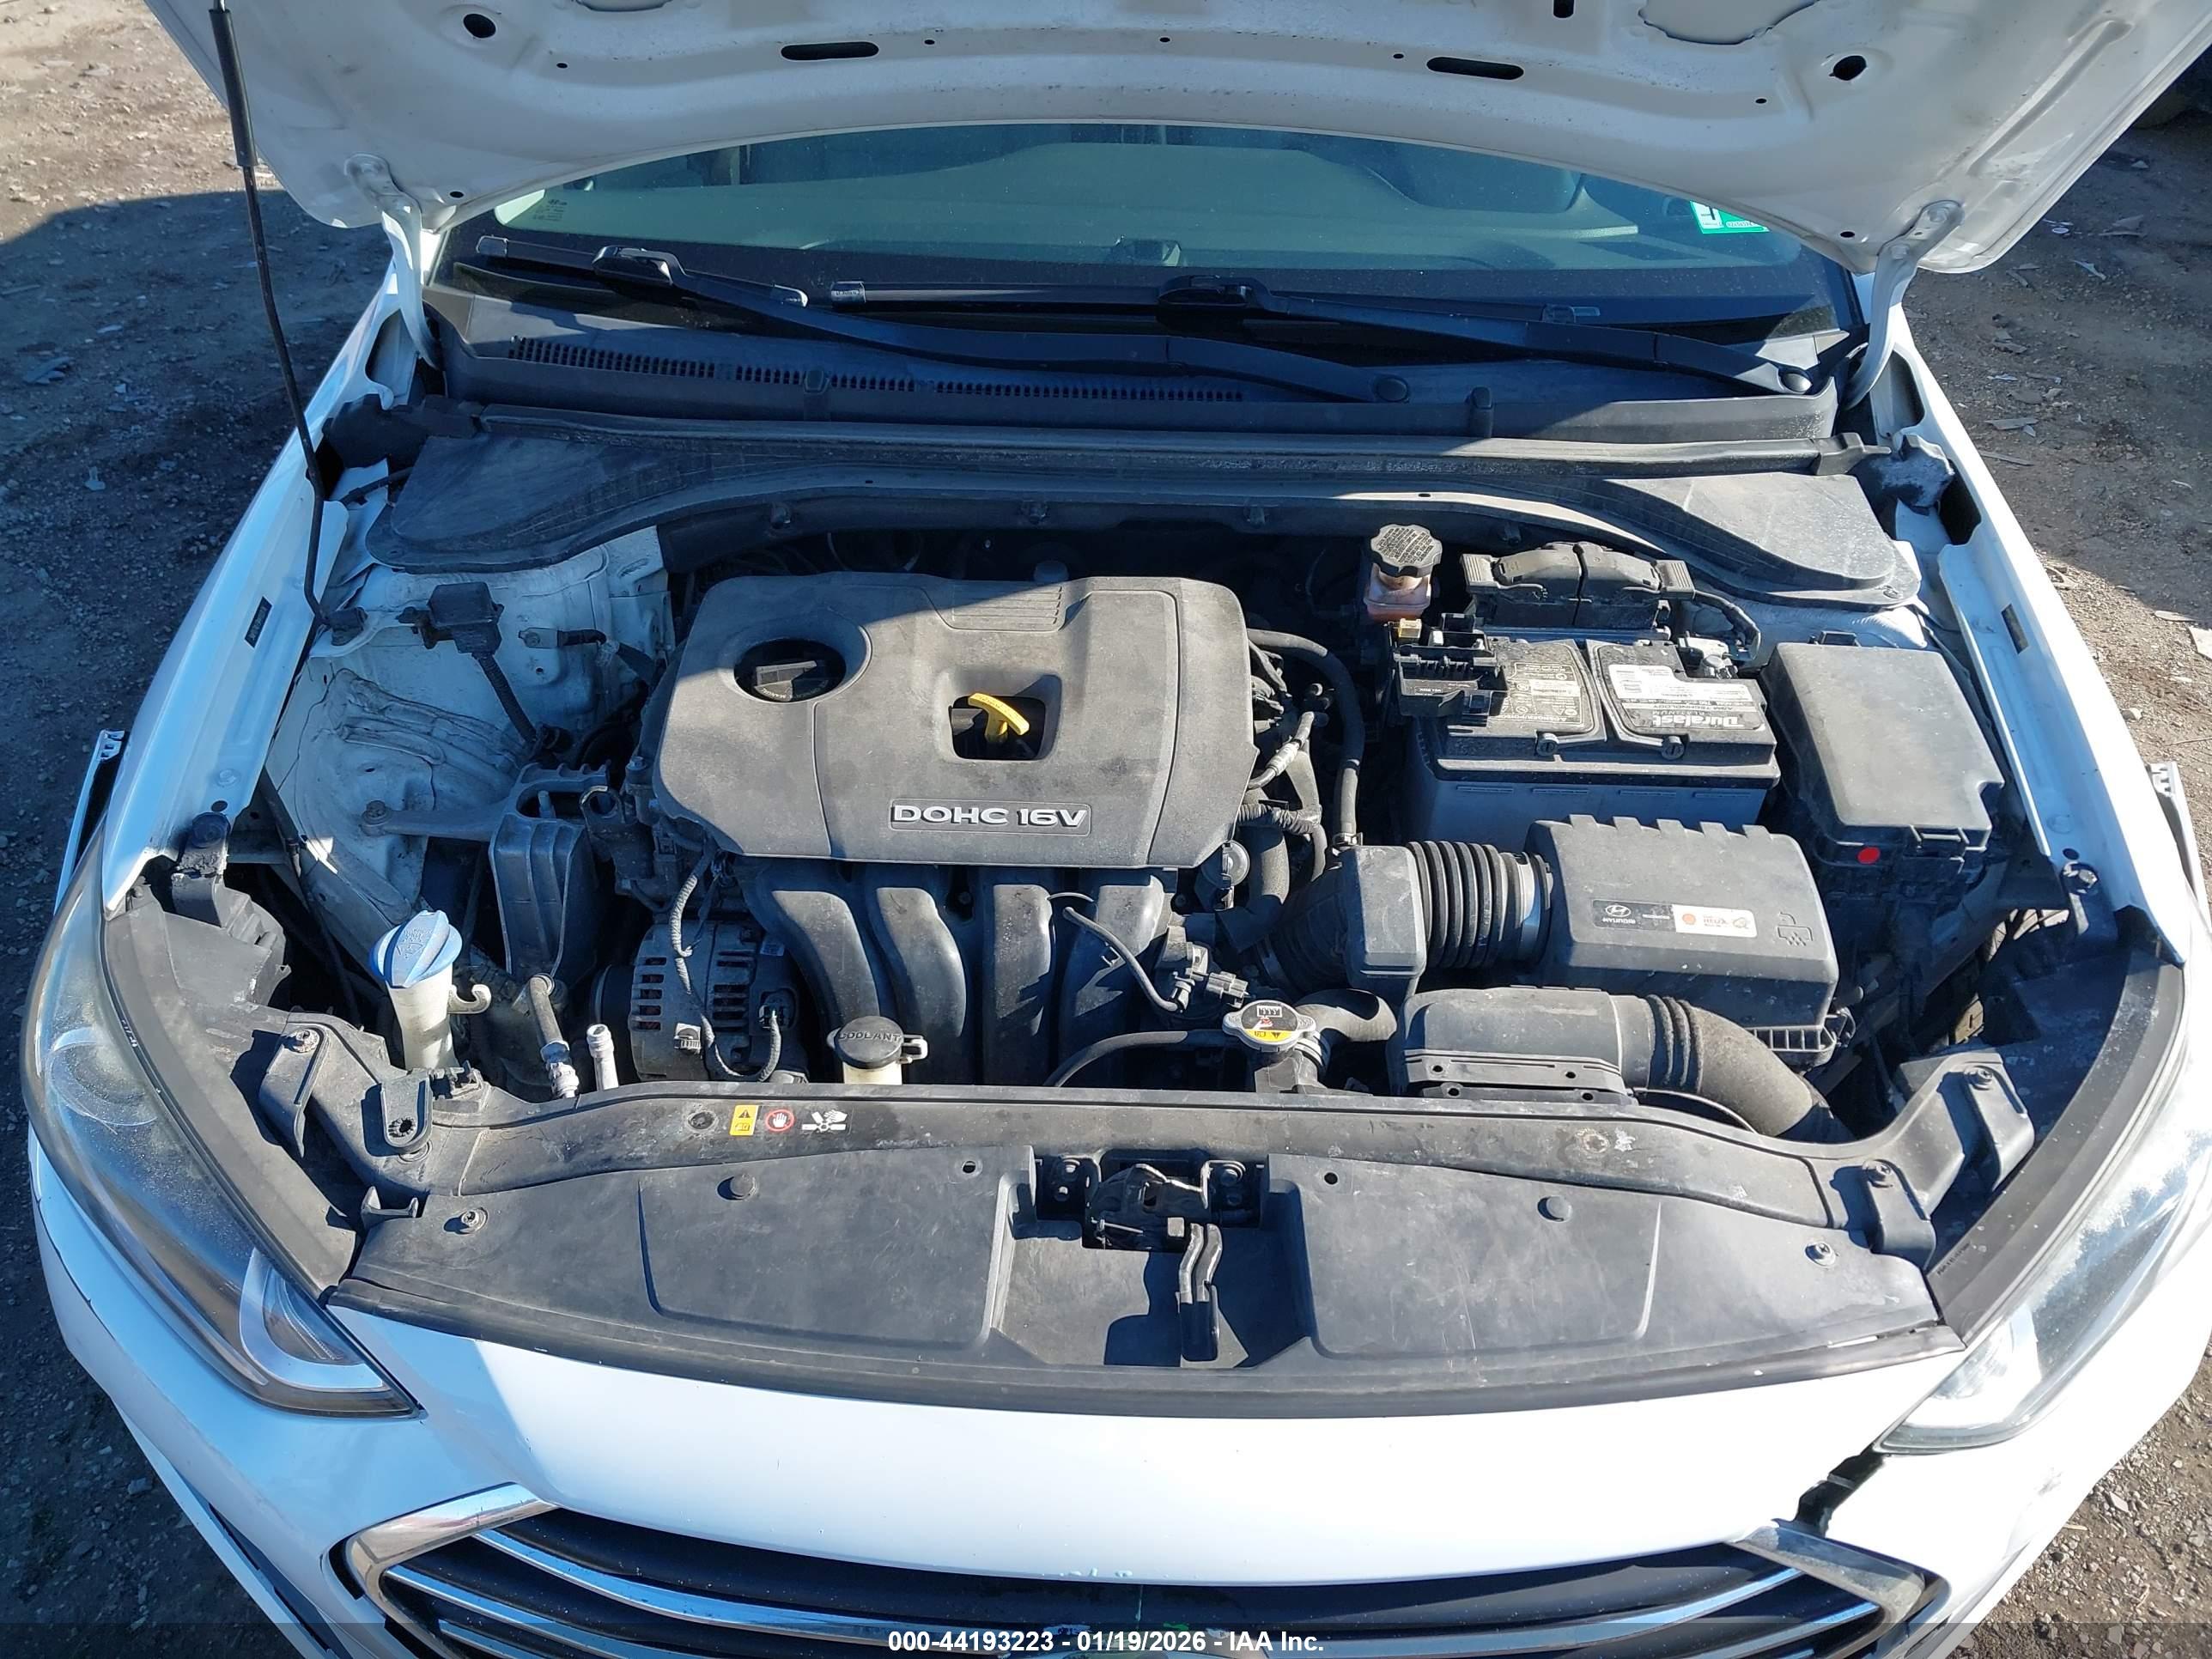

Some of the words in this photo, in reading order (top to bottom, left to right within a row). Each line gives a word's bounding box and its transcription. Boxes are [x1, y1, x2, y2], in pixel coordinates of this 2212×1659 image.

[1652, 714, 1745, 727] Duralast
[890, 805, 1009, 824] DOHC
[1017, 808, 1088, 827] 16V
[838, 1030, 902, 1043] COOLANT
